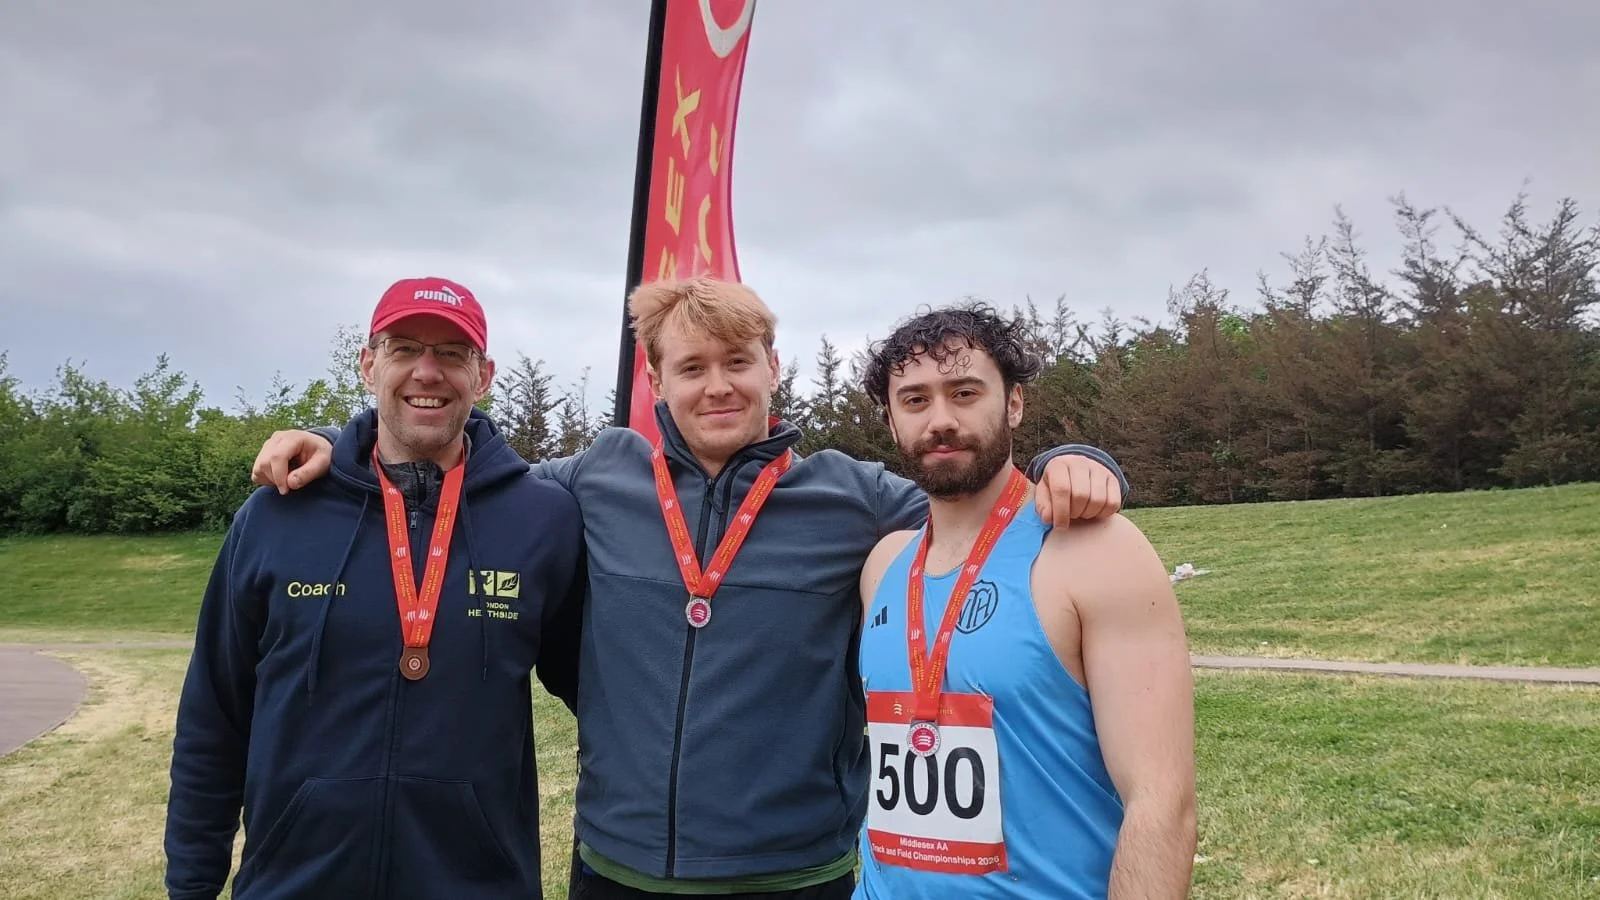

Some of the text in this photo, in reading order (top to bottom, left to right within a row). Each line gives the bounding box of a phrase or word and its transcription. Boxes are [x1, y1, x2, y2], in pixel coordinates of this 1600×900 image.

[413, 290, 457, 306] PUMA
[287, 580, 346, 598] Coach
[467, 608, 520, 620] HETHSIDE
[876, 742, 986, 820] 500
[896, 848, 912, 859] Field
[936, 841, 949, 852] AA
